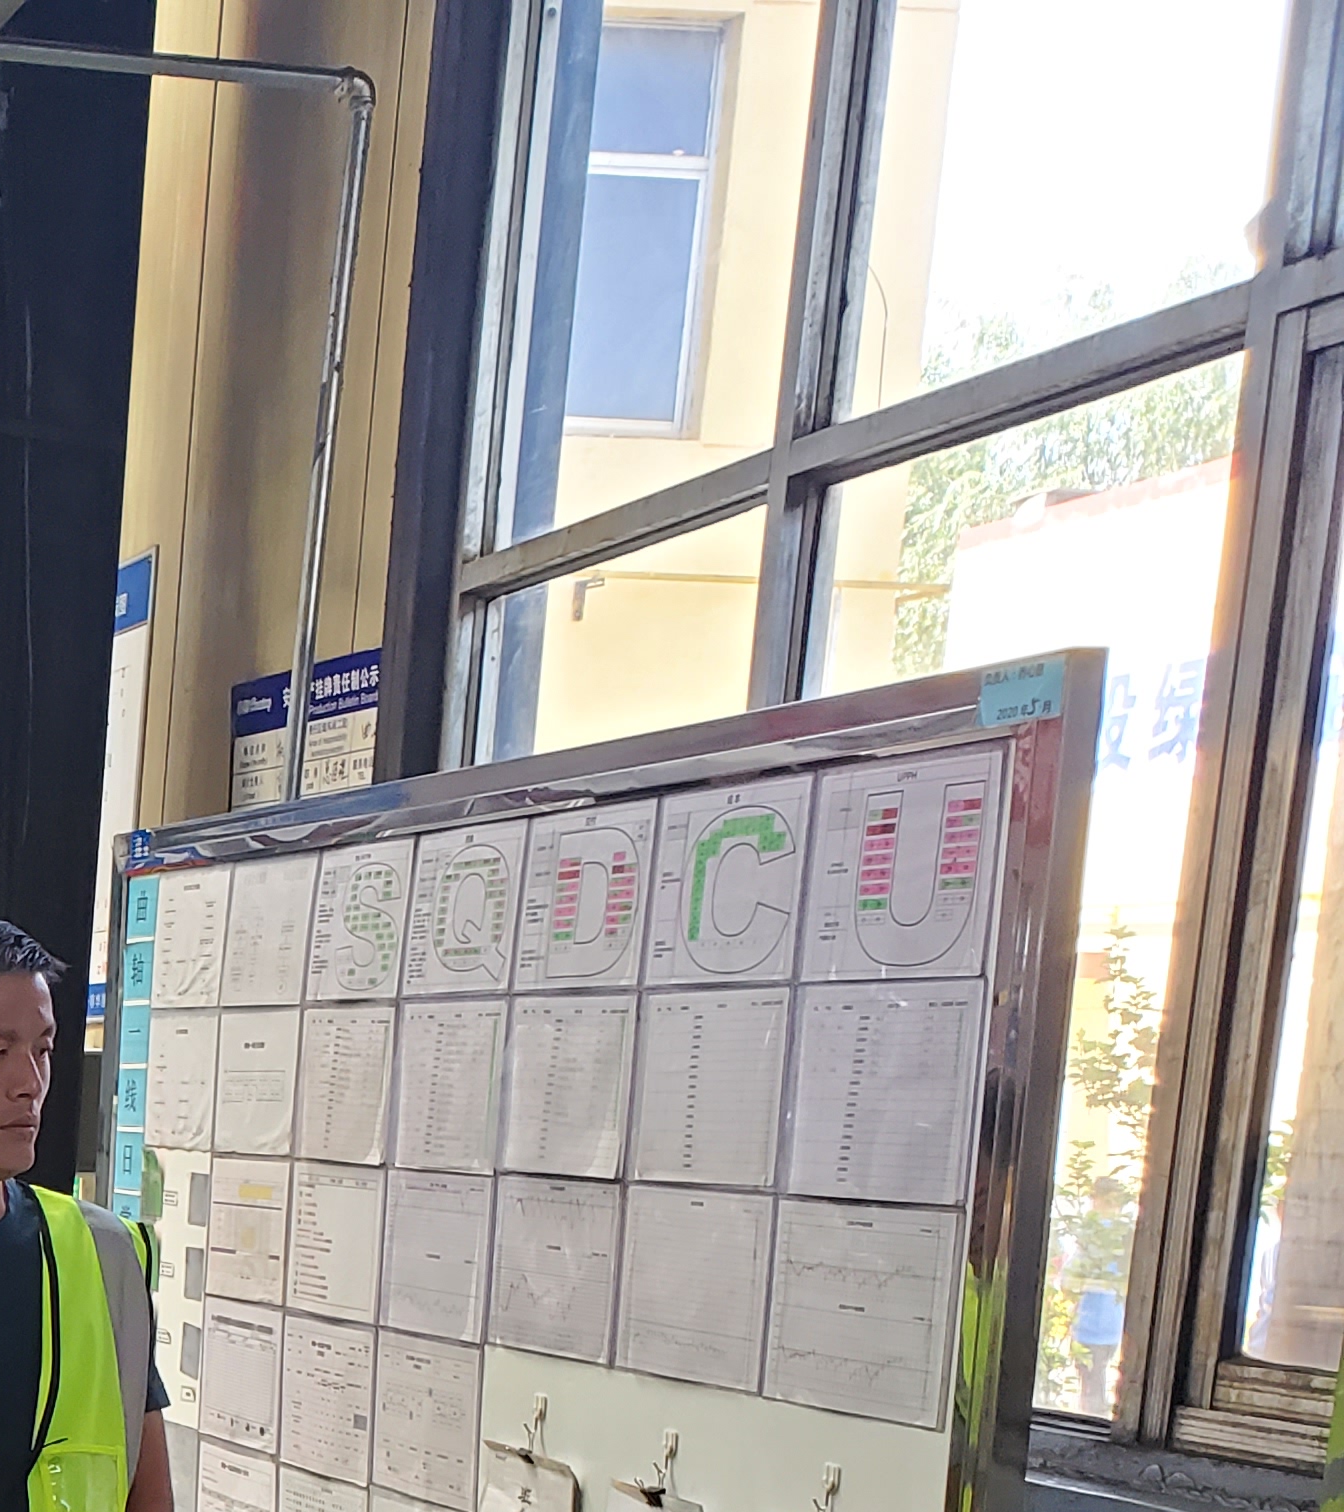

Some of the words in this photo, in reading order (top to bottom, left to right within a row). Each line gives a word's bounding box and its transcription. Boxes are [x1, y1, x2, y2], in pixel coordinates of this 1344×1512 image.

[334, 861, 402, 992] S
[434, 843, 507, 981] Q
[546, 826, 639, 979] D
[680, 804, 796, 974] C
[854, 780, 986, 967] U
